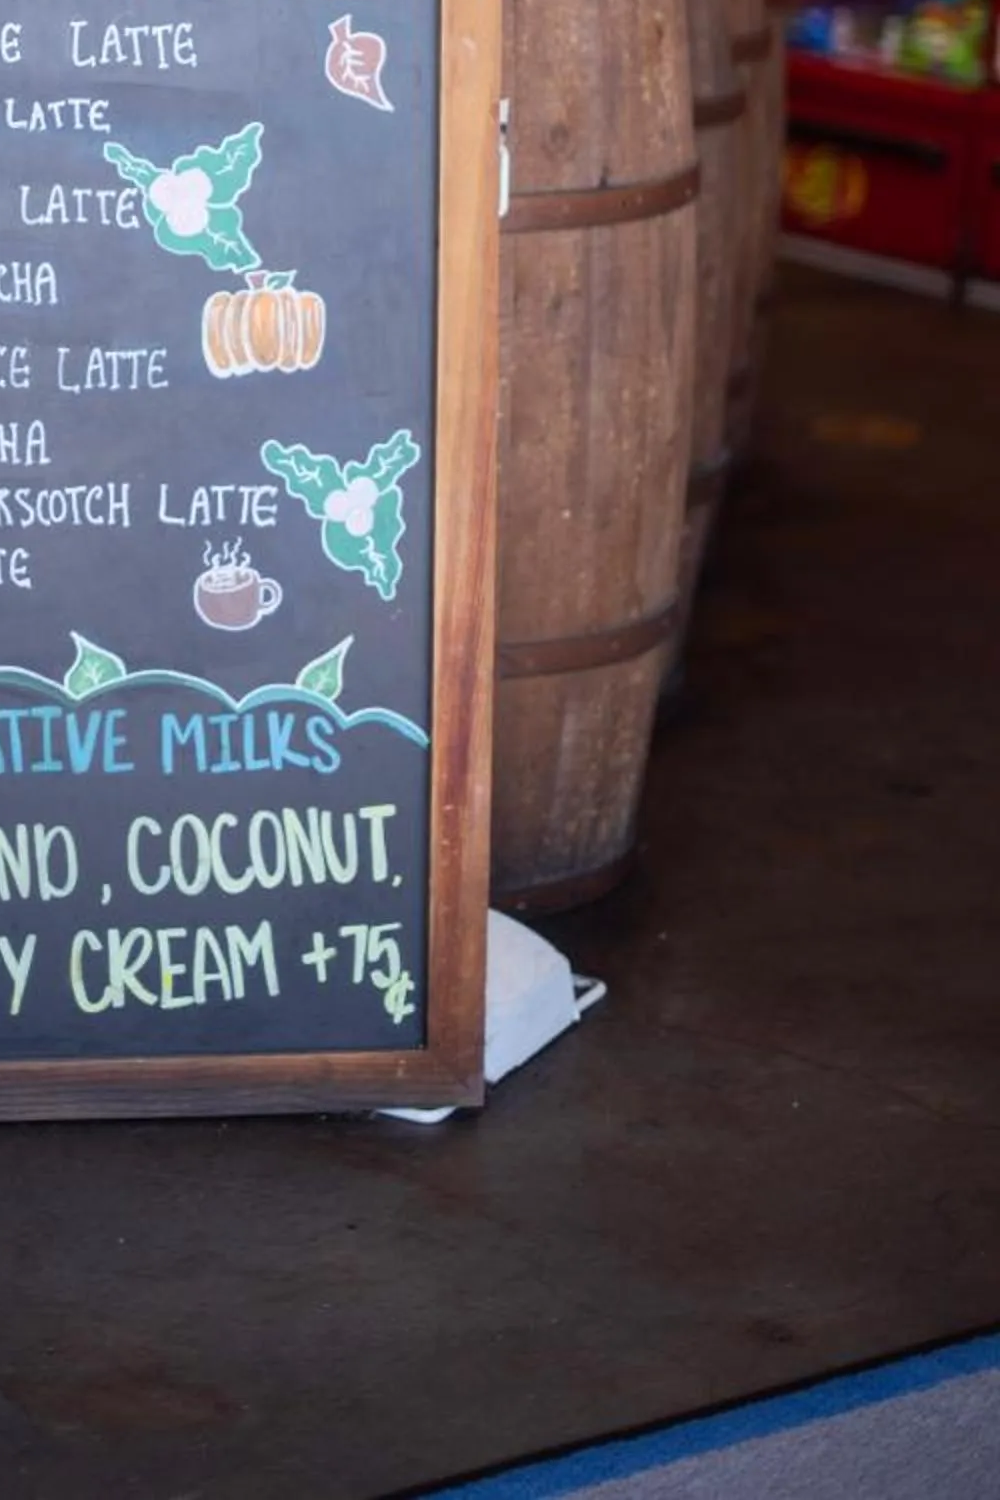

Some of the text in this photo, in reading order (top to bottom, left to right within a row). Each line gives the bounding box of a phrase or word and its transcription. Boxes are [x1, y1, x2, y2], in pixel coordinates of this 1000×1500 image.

[70, 20, 198, 69] LATTE
[4, 98, 112, 133] LATTE
[19, 184, 141, 229] LATTE
[57, 347, 169, 393] LATTE
[159, 483, 279, 527] LATTE
[161, 711, 341, 775] MILKS
[127, 804, 402, 896] COCONUT,
[70, 920, 280, 1014] CREAM
